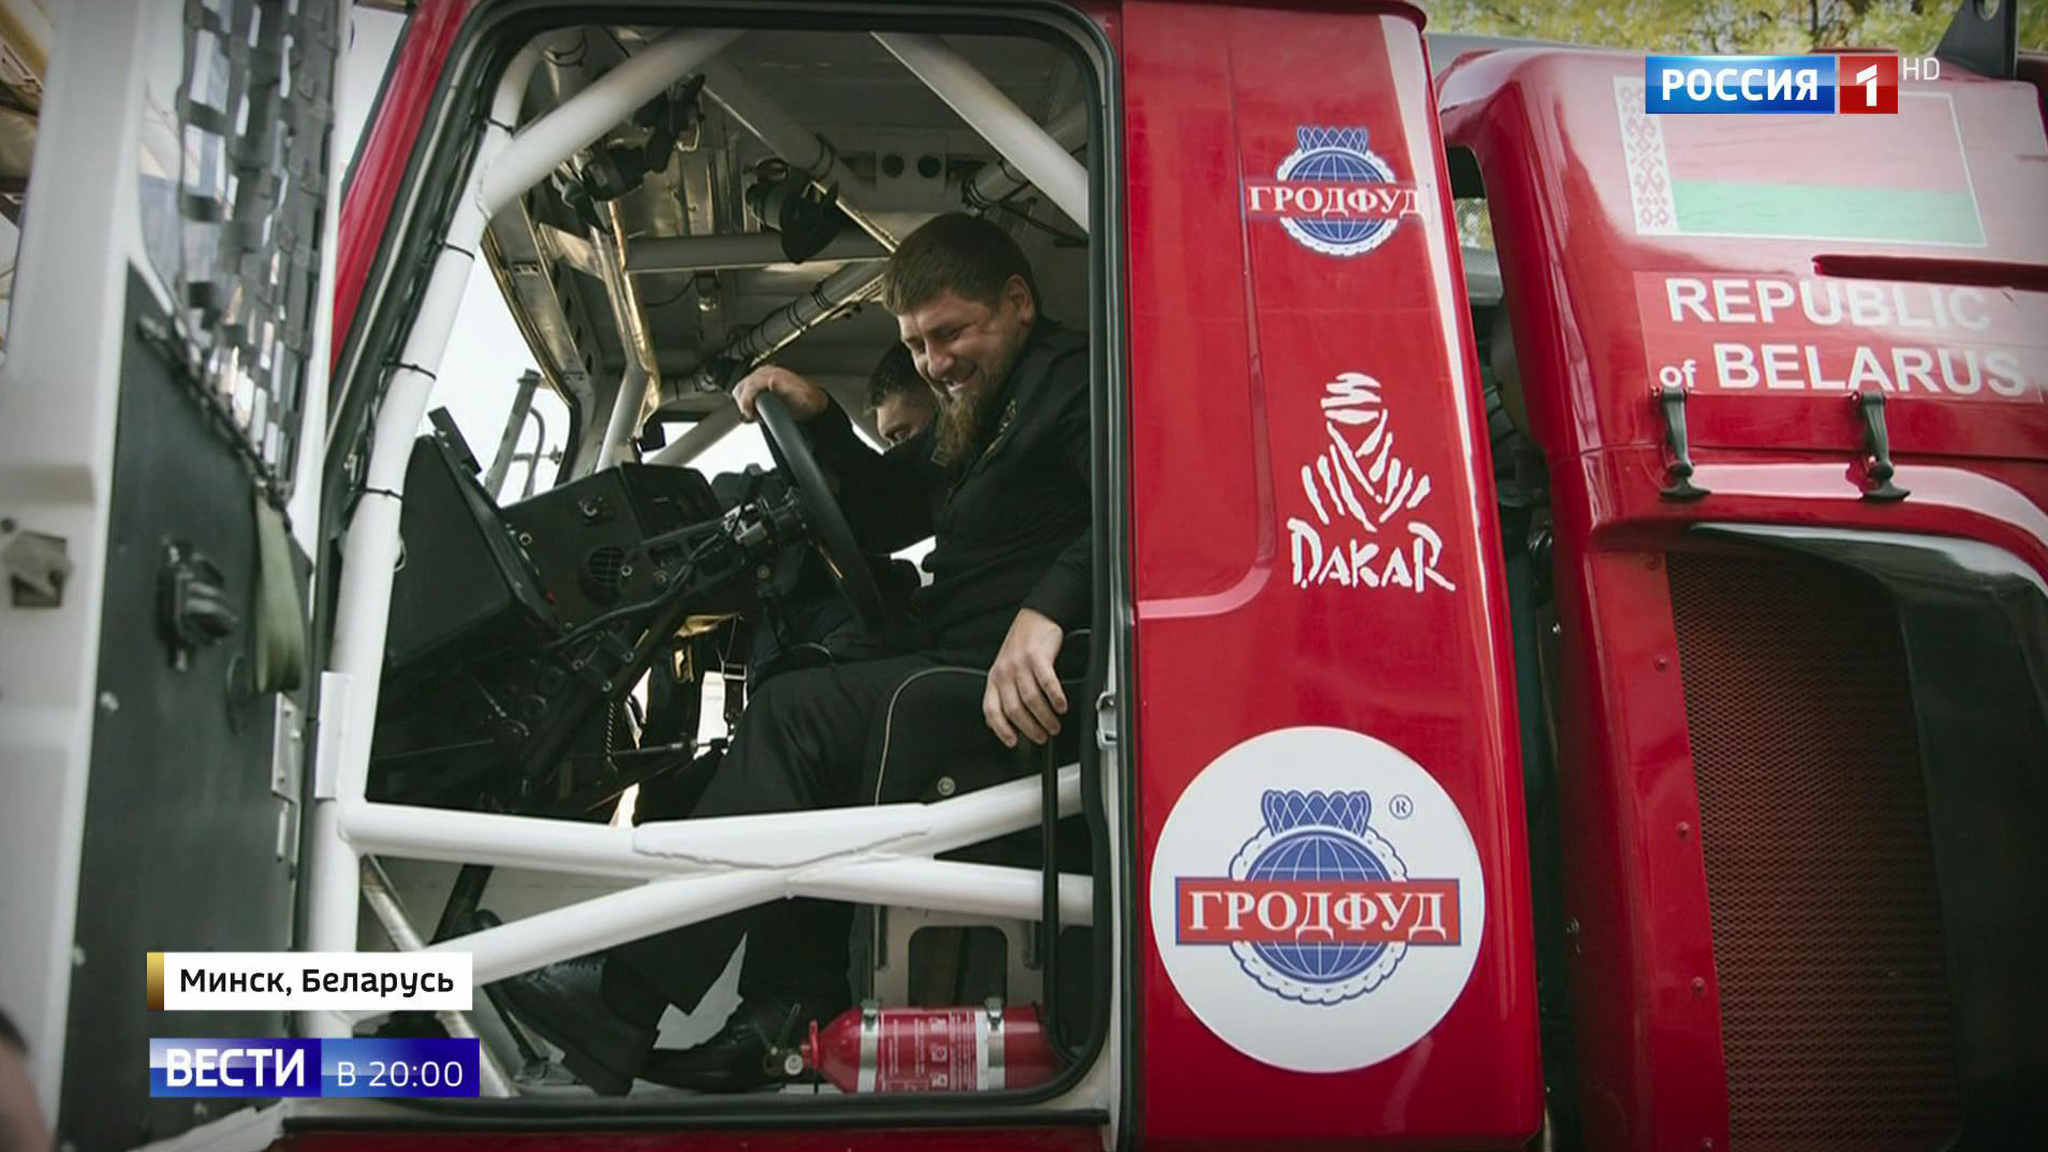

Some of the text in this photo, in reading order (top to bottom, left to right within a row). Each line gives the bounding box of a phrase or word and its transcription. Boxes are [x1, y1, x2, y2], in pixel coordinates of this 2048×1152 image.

[1249, 185, 1420, 218] ГРОДФУД
[1665, 277, 1991, 331] REPUBLIC
[1659, 343, 2025, 396] of BELARUS
[1287, 517, 1456, 593] DAKAR
[1188, 891, 1447, 941] ГРОДФУД
